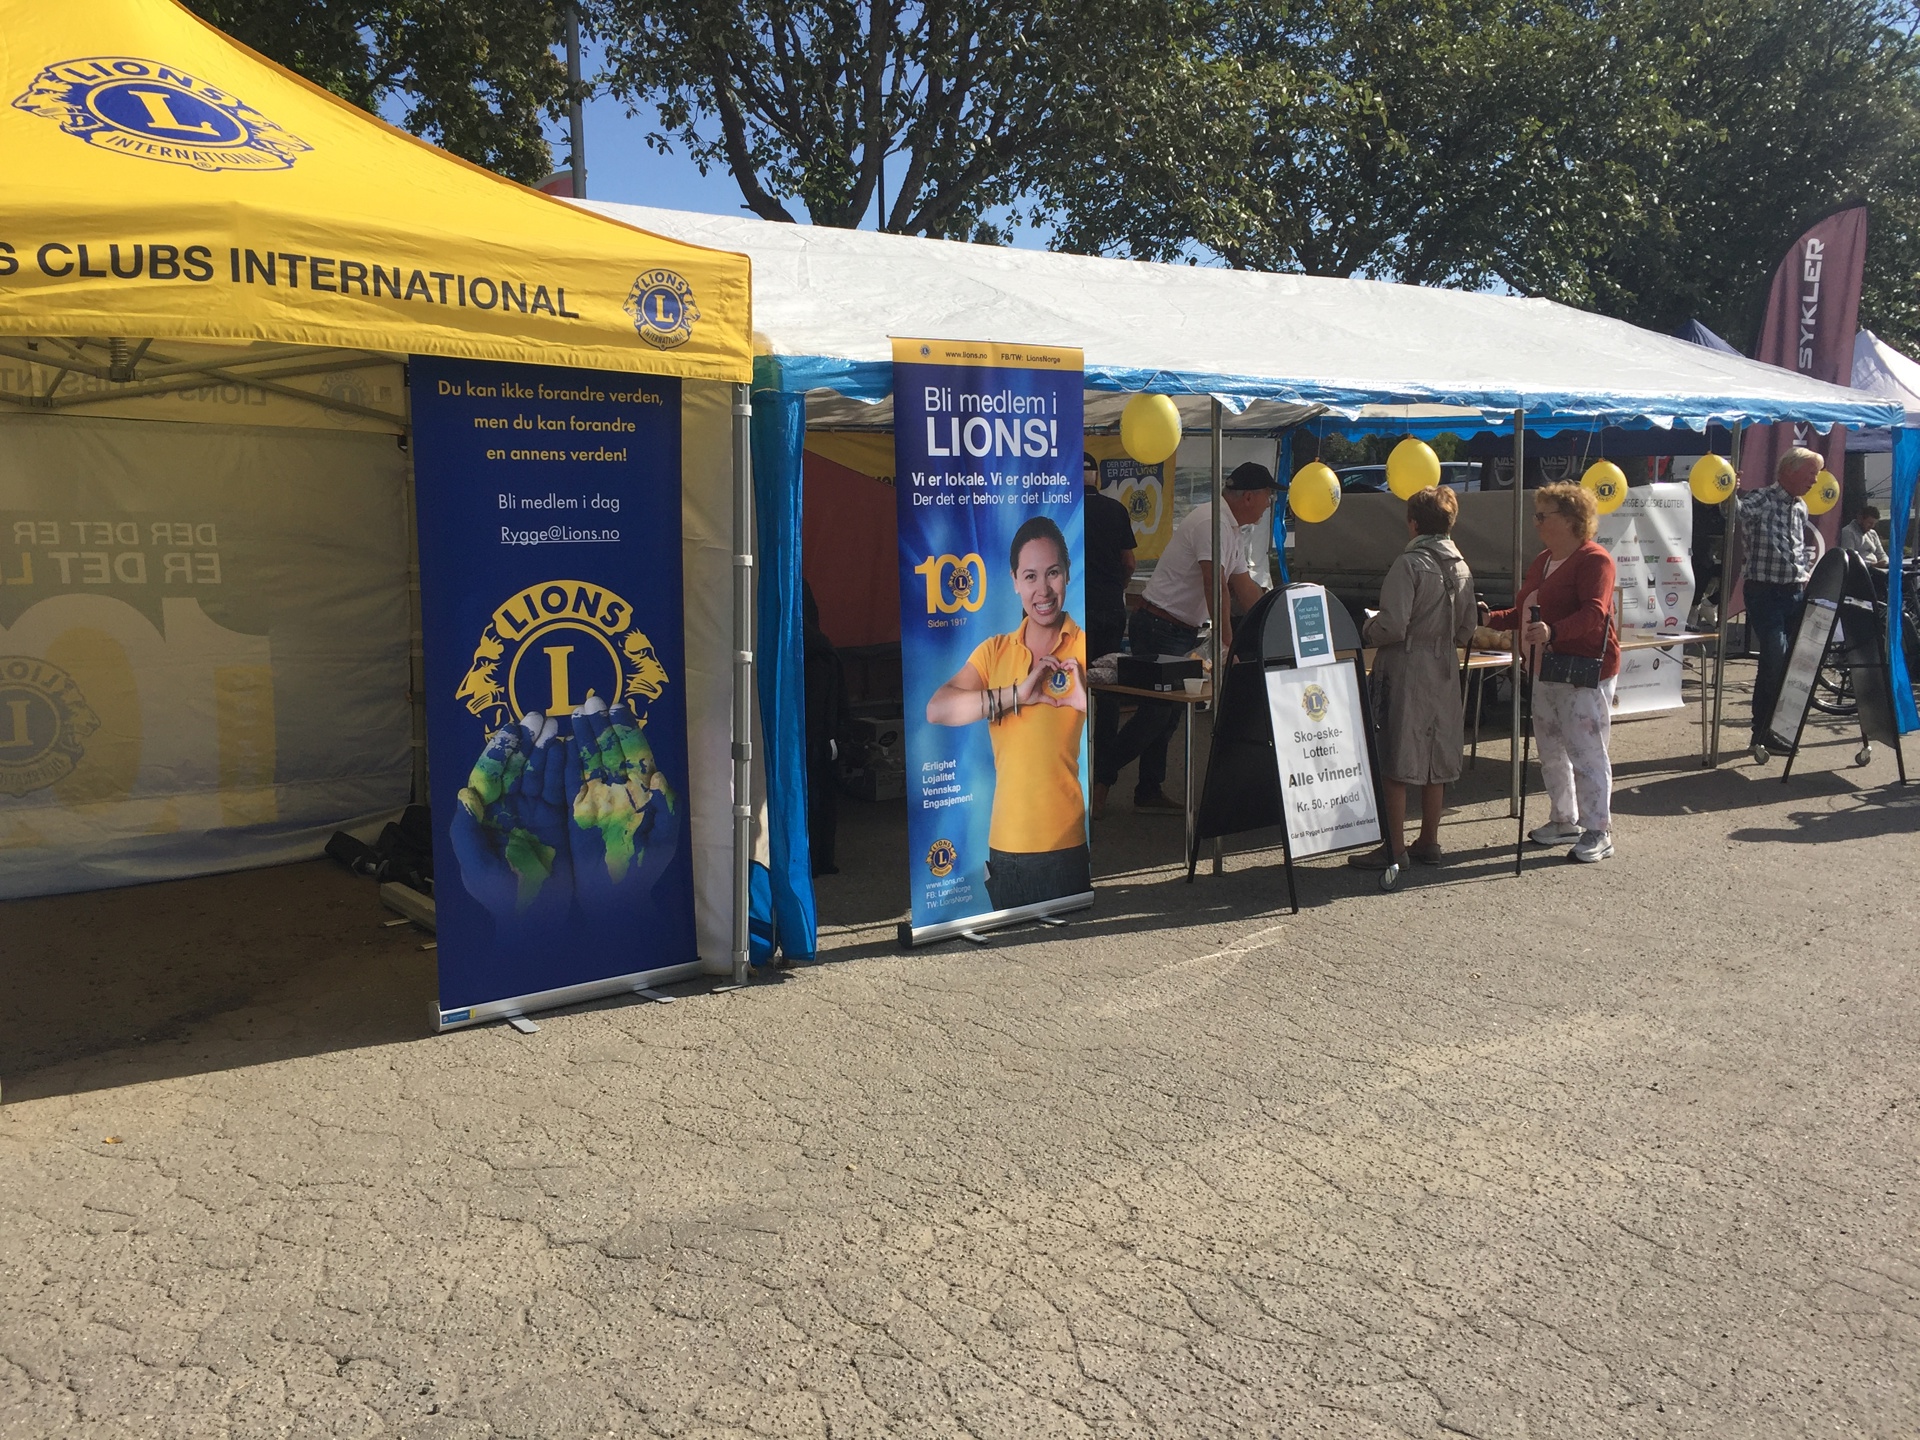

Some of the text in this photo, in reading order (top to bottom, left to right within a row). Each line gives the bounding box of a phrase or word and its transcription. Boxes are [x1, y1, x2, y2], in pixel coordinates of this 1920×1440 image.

[64, 61, 224, 102] LIONS
[128, 89, 221, 137] L
[105, 136, 275, 165] INTERNATIONAL
[37, 243, 214, 281] CLUBS
[231, 248, 579, 320] INTERNATIONAL
[641, 272, 685, 292] LIONS
[654, 294, 675, 323] L
[1799, 237, 1825, 370] SYKLER
[643, 328, 687, 345] INTERNATIONAL
[945, 351, 1061, 364] www.lions.no FB/TW: LionsNorge
[438, 380, 663, 406] Du kan ikke forandre verden,
[925, 387, 1057, 415] Bli medlem i
[474, 415, 635, 432] men du kan forandre
[927, 416, 1058, 458] LIONS!
[486, 447, 627, 462] en annens verden!
[1107, 468, 1119, 477] ER
[1120, 467, 1134, 477] DET
[1120, 460, 1131, 468] DET
[912, 472, 1070, 489] Vi er lokale. Vi er globale.
[498, 494, 516, 509] Bli
[521, 494, 577, 509] medlem
[591, 495, 620, 513] dag
[913, 490, 1072, 506] Der det er behov er det Lions!
[501, 526, 620, 545] Rygge@Lions.no
[914, 553, 987, 614] 100
[502, 585, 626, 634] LIONS
[927, 617, 967, 628] Siden 1917
[1294, 726, 1343, 744] Sko-eske-
[1303, 743, 1339, 760] Lotteri.
[922, 759, 957, 772] Ærlighet
[922, 772, 956, 785] Lojalitet
[1289, 762, 1363, 789] Alle vinner!
[922, 784, 961, 796] Vennskap
[1296, 790, 1360, 813] Kr. 50,- pr.lodd
[1305, 829, 1320, 838] Rygge
[932, 841, 951, 850] LIONS
[925, 876, 965, 890] www.lions.no
[926, 885, 972, 900] FB: LionsNorge
[926, 894, 974, 909] TW: LionsNorge
